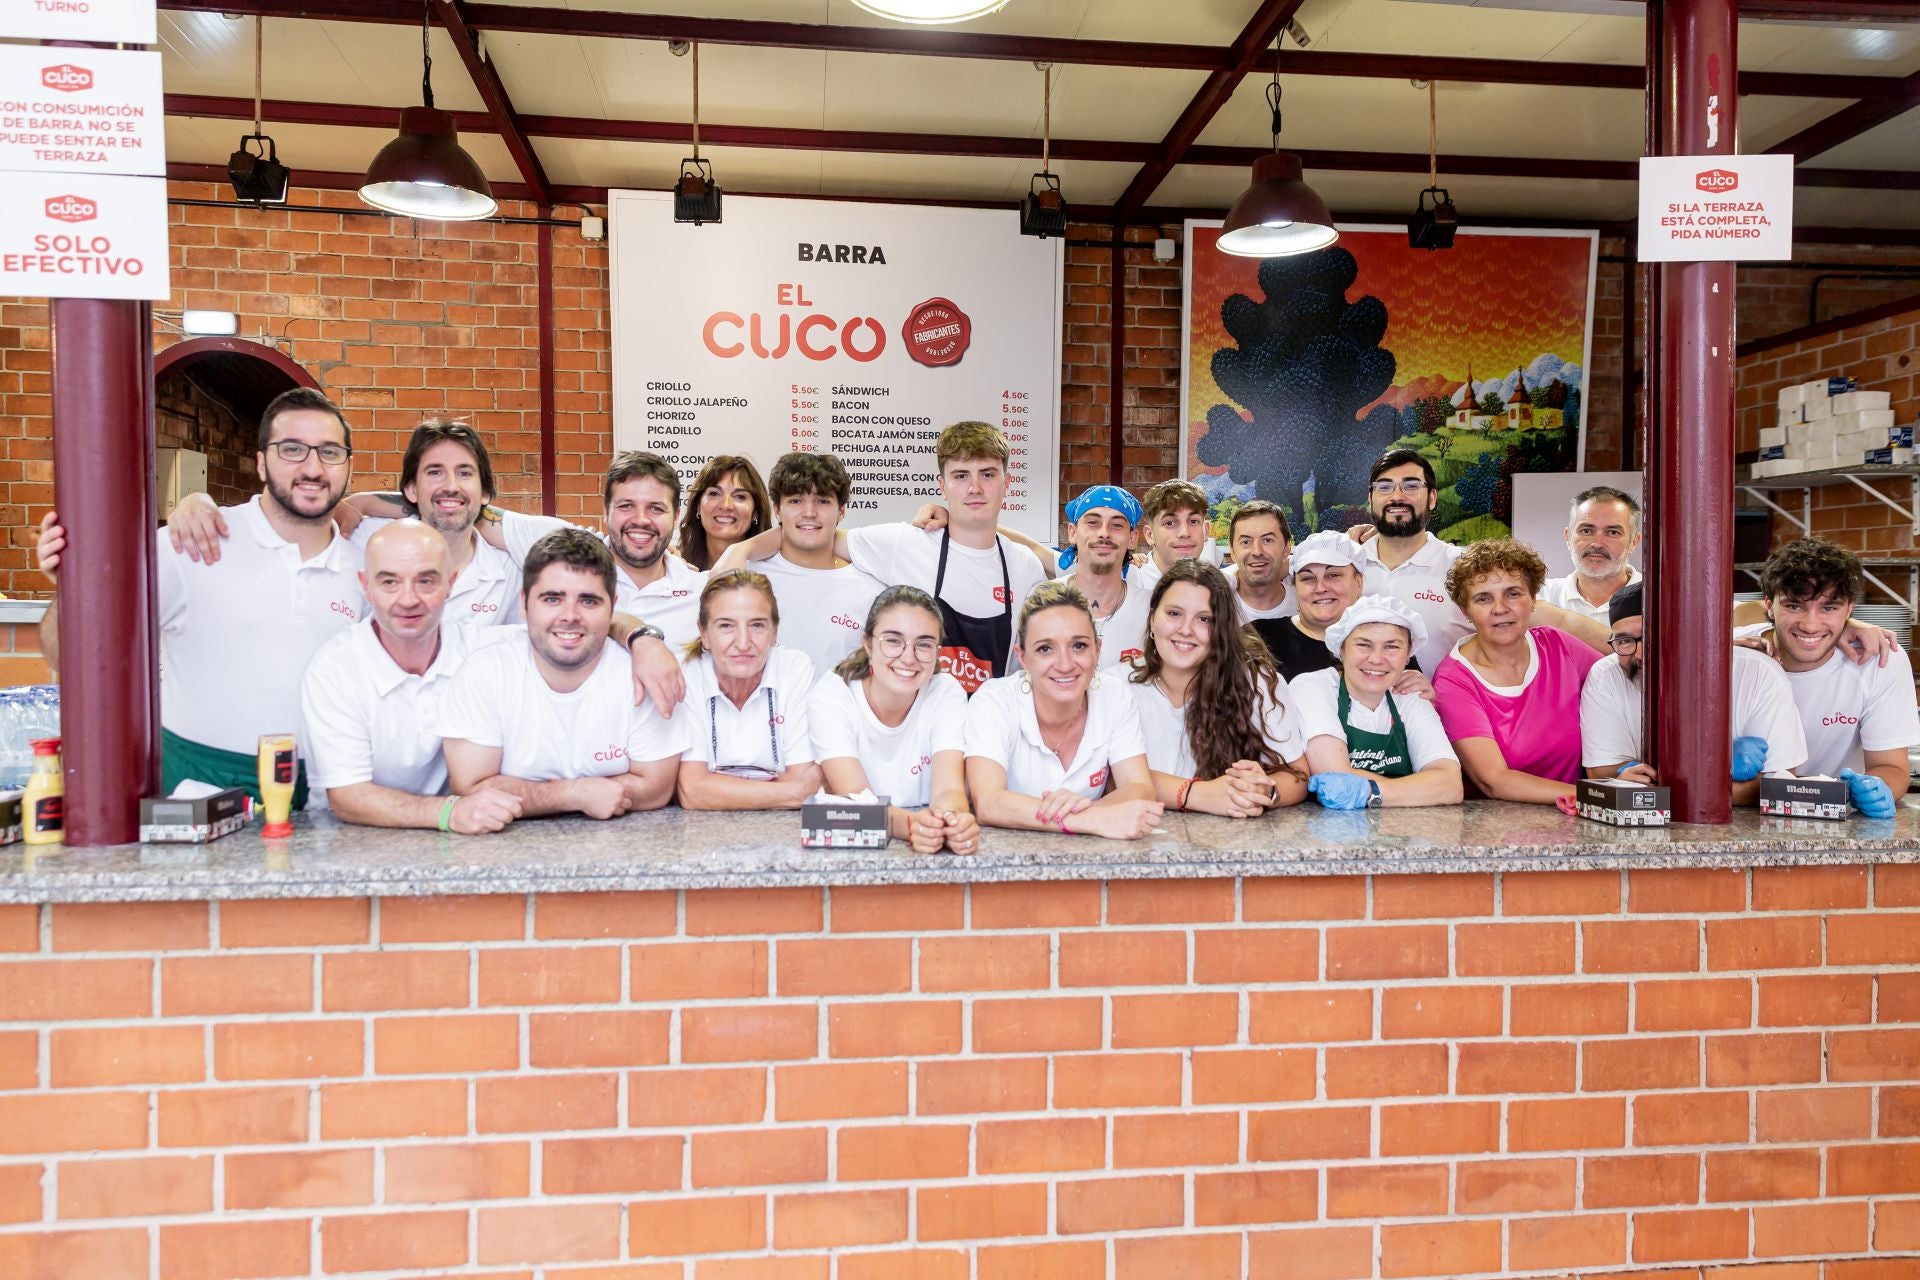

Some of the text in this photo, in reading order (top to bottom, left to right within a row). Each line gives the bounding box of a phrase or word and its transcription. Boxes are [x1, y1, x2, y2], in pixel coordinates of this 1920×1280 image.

[34, 0, 89, 13] TURNO
[45, 71, 90, 84] CUCO
[0, 101, 144, 117] ON CONSUMICIÓN
[4, 117, 135, 132] DE BARRA NO SE
[0, 132, 142, 148] PUEDE SENTAR EN
[34, 149, 108, 162] TERRAZA
[1699, 176, 1735, 186] CUCO
[48, 202, 94, 215] CUCO
[1668, 202, 1764, 213] SI LA TERRAZA
[1661, 214, 1771, 226] ESTÁ COMPLETA,
[1671, 227, 1760, 239] PIDA NÚMERO
[34, 234, 111, 254] SOLO
[798, 242, 887, 265] BARRA
[4, 254, 144, 276] EFECTIVO
[777, 283, 813, 307] EL
[702, 311, 887, 363] CUCO
[914, 324, 960, 343] FABRICANTES
[647, 382, 819, 394] CRIOLLO 5.50€
[832, 384, 1029, 399] SÁNDWICH 4.50€
[647, 396, 819, 408] CRIOLLO JALAPEÑO 5.50€
[832, 401, 1029, 413] BACON 5.50€
[647, 411, 819, 423] CHORIZO 5.00€
[832, 415, 1029, 427] BACON CON QUESO 6.00€
[648, 426, 819, 437] PICADILLO 6.00€
[832, 430, 875, 438] BOCATA
[877, 429, 914, 439] JAMÓN
[917, 431, 941, 440] SERR
[648, 441, 819, 452] LOMO 5.50€
[832, 444, 1028, 456] PECHUGA A LA PLANC .00€
[681, 455, 705, 464] CON
[840, 458, 1028, 470] AMBURGUESA .50€
[847, 473, 909, 482] MBURGUESA
[911, 474, 934, 482] CON
[849, 487, 912, 496] MBURGUESA,
[914, 488, 942, 496] BACO
[846, 501, 878, 509] TATAS
[1414, 592, 1444, 602] CUCO
[331, 602, 354, 618] CUCO
[831, 615, 860, 630] CUCO
[959, 651, 970, 660] EL
[938, 656, 990, 682] CUCO
[1822, 715, 1857, 726] CUCO
[1588, 788, 1605, 798] Mahou
[1786, 785, 1820, 794] Mahou
[826, 810, 860, 820] Mahou
